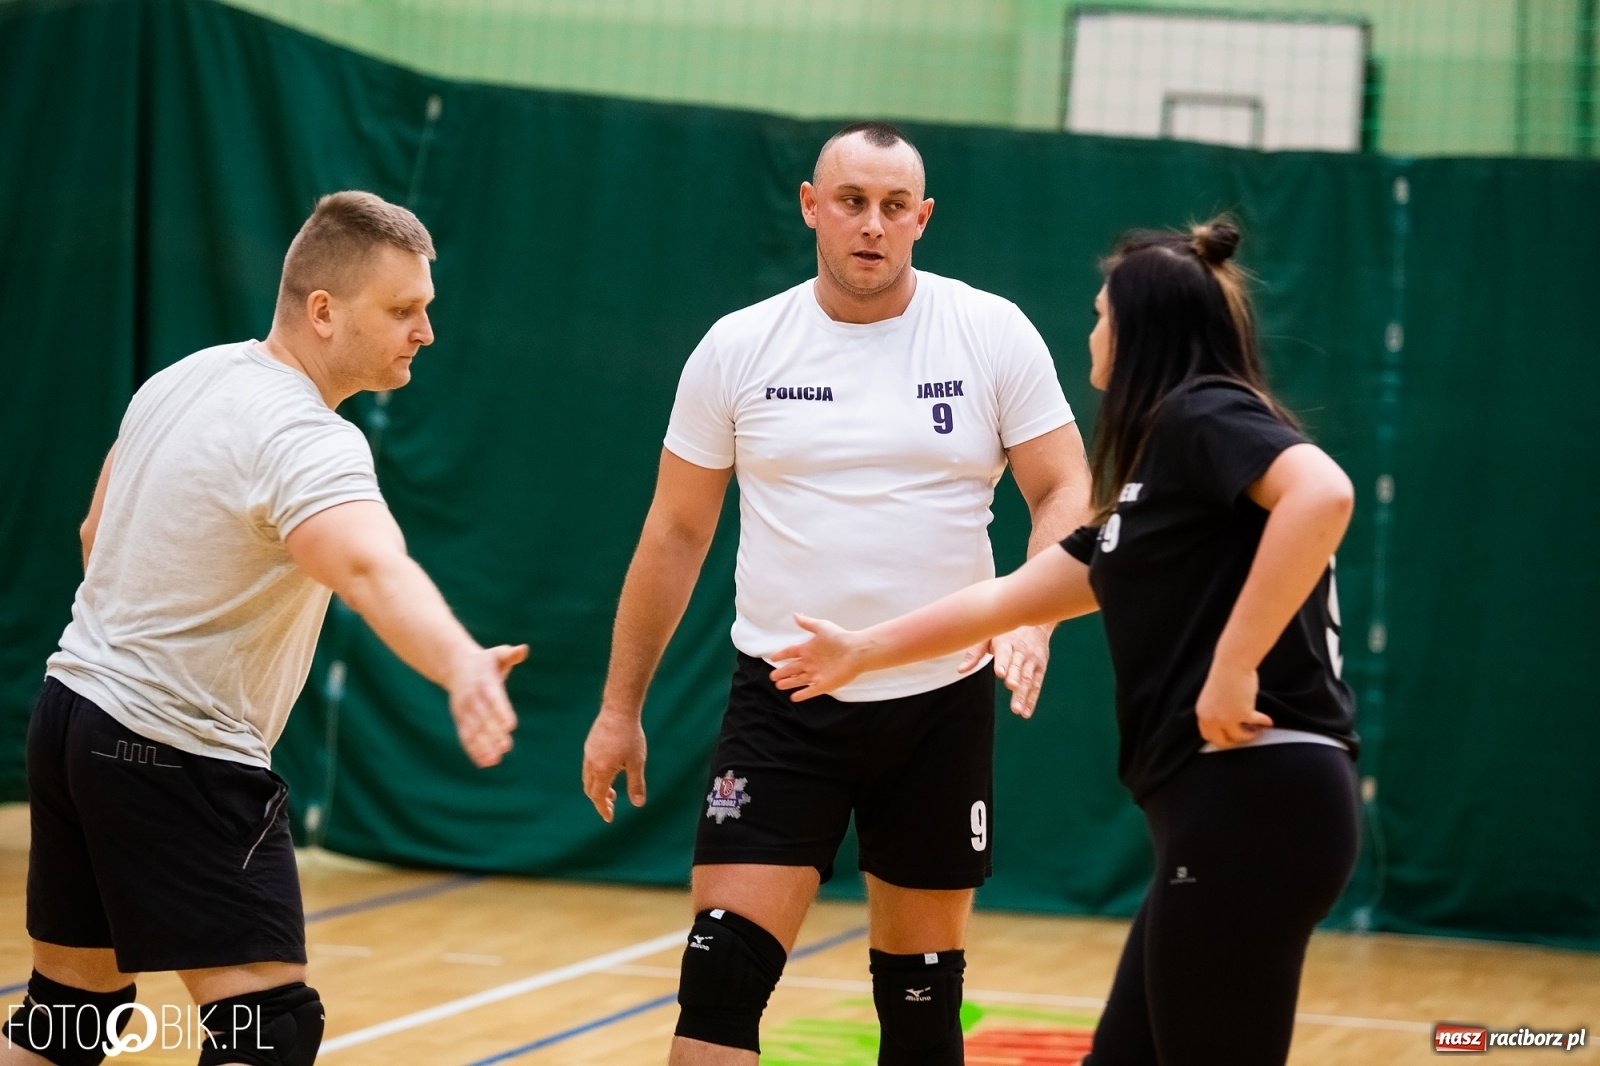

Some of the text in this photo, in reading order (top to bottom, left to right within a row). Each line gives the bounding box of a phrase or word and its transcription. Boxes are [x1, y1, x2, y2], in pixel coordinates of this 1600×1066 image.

[765, 386, 834, 402] POLICJA
[916, 380, 964, 399] JAREK
[932, 402, 954, 435] 9
[970, 800, 987, 852] 9
